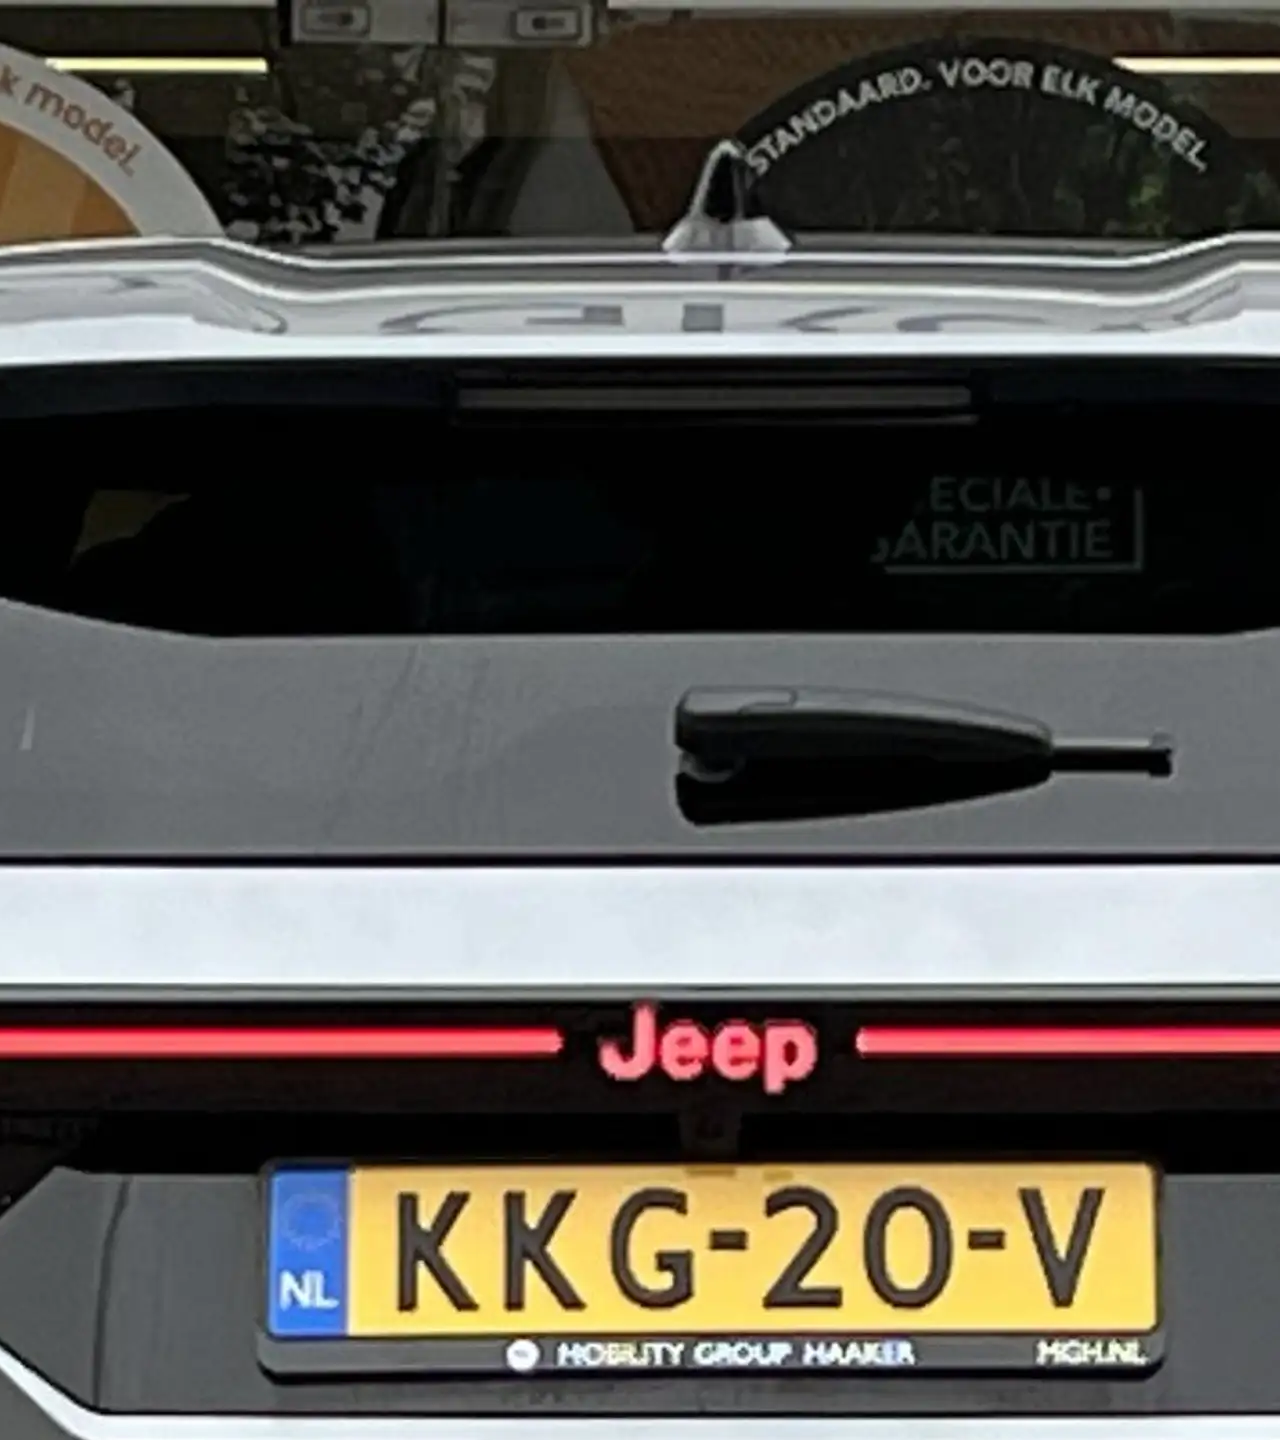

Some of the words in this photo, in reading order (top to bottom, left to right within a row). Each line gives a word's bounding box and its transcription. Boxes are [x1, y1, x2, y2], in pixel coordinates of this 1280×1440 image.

[24, 81, 142, 177] model.
[745, 66, 933, 176] STANDAARD.
[939, 57, 1034, 89] VOOR
[1040, 64, 1104, 106] ELK
[925, 474, 1092, 513] ECIALE
[599, 1000, 818, 1094] Jeep
[279, 1270, 339, 1309] NL
[396, 1185, 1105, 1312] KKG-20-V
[557, 1341, 684, 1366] MOBILITY
[693, 1341, 793, 1366] GROUP
[802, 1341, 915, 1366] HAAKER
